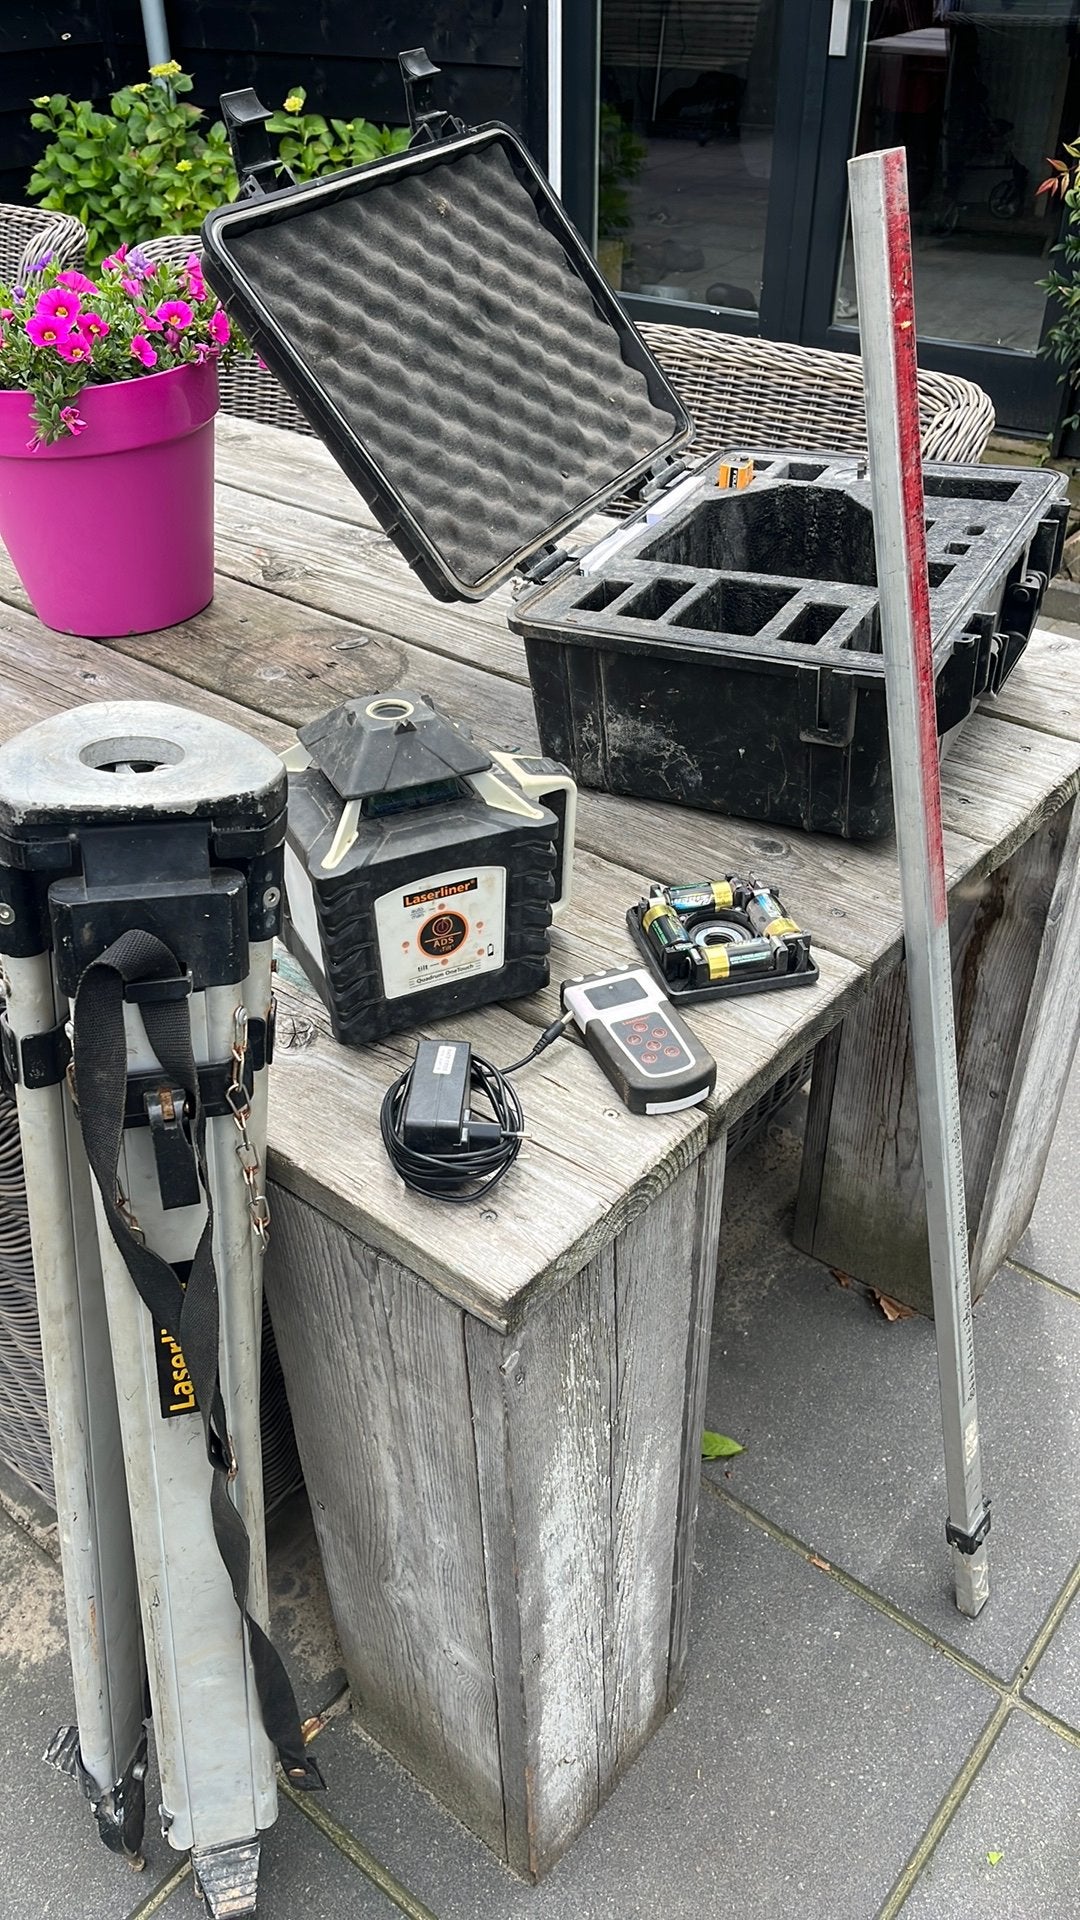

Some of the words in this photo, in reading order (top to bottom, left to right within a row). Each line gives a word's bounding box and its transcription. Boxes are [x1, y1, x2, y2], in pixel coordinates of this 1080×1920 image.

[433, 936, 454, 948] ADS
[417, 964, 428, 972] tilt
[416, 973, 444, 983] Quadrum
